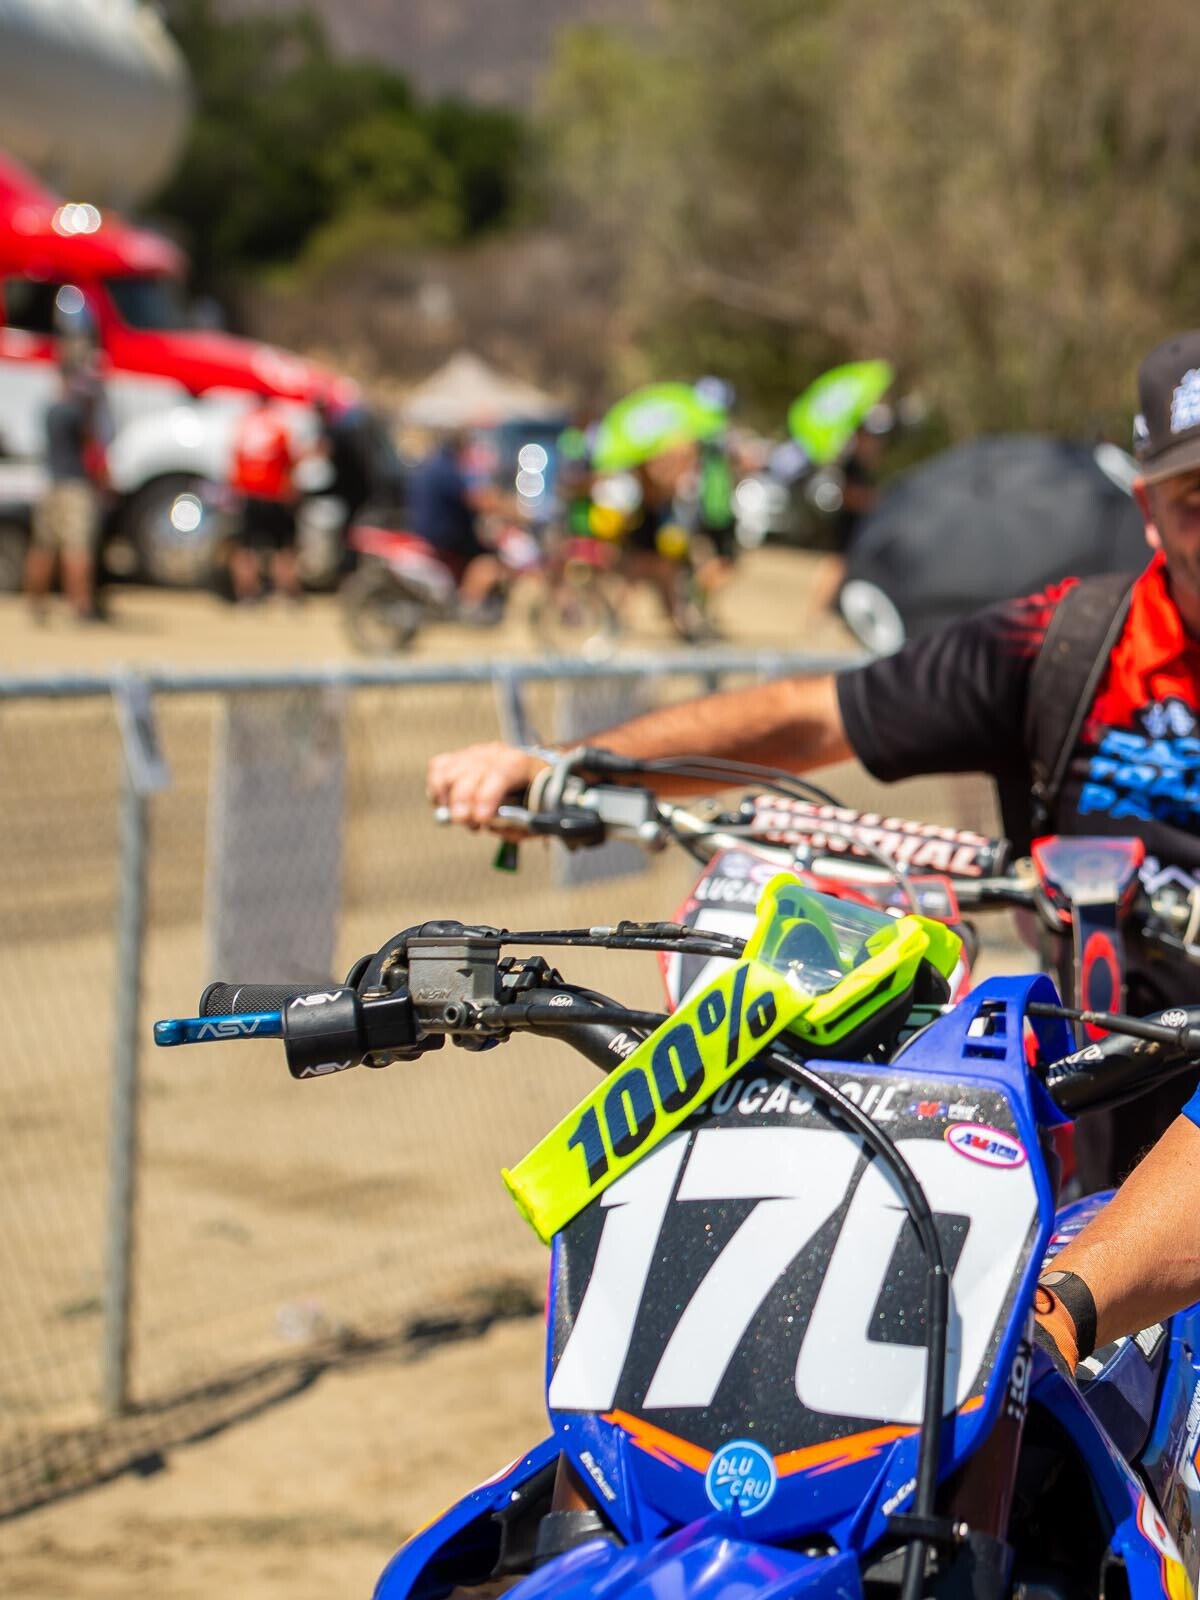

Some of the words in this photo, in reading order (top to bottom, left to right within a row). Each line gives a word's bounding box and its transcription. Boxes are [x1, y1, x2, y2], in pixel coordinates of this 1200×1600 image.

[291, 991, 343, 1009] ASV
[197, 1018, 261, 1038] ASV
[300, 1060, 351, 1078] ASV
[568, 964, 777, 1188] 100%
[549, 1126, 1038, 1425] 170
